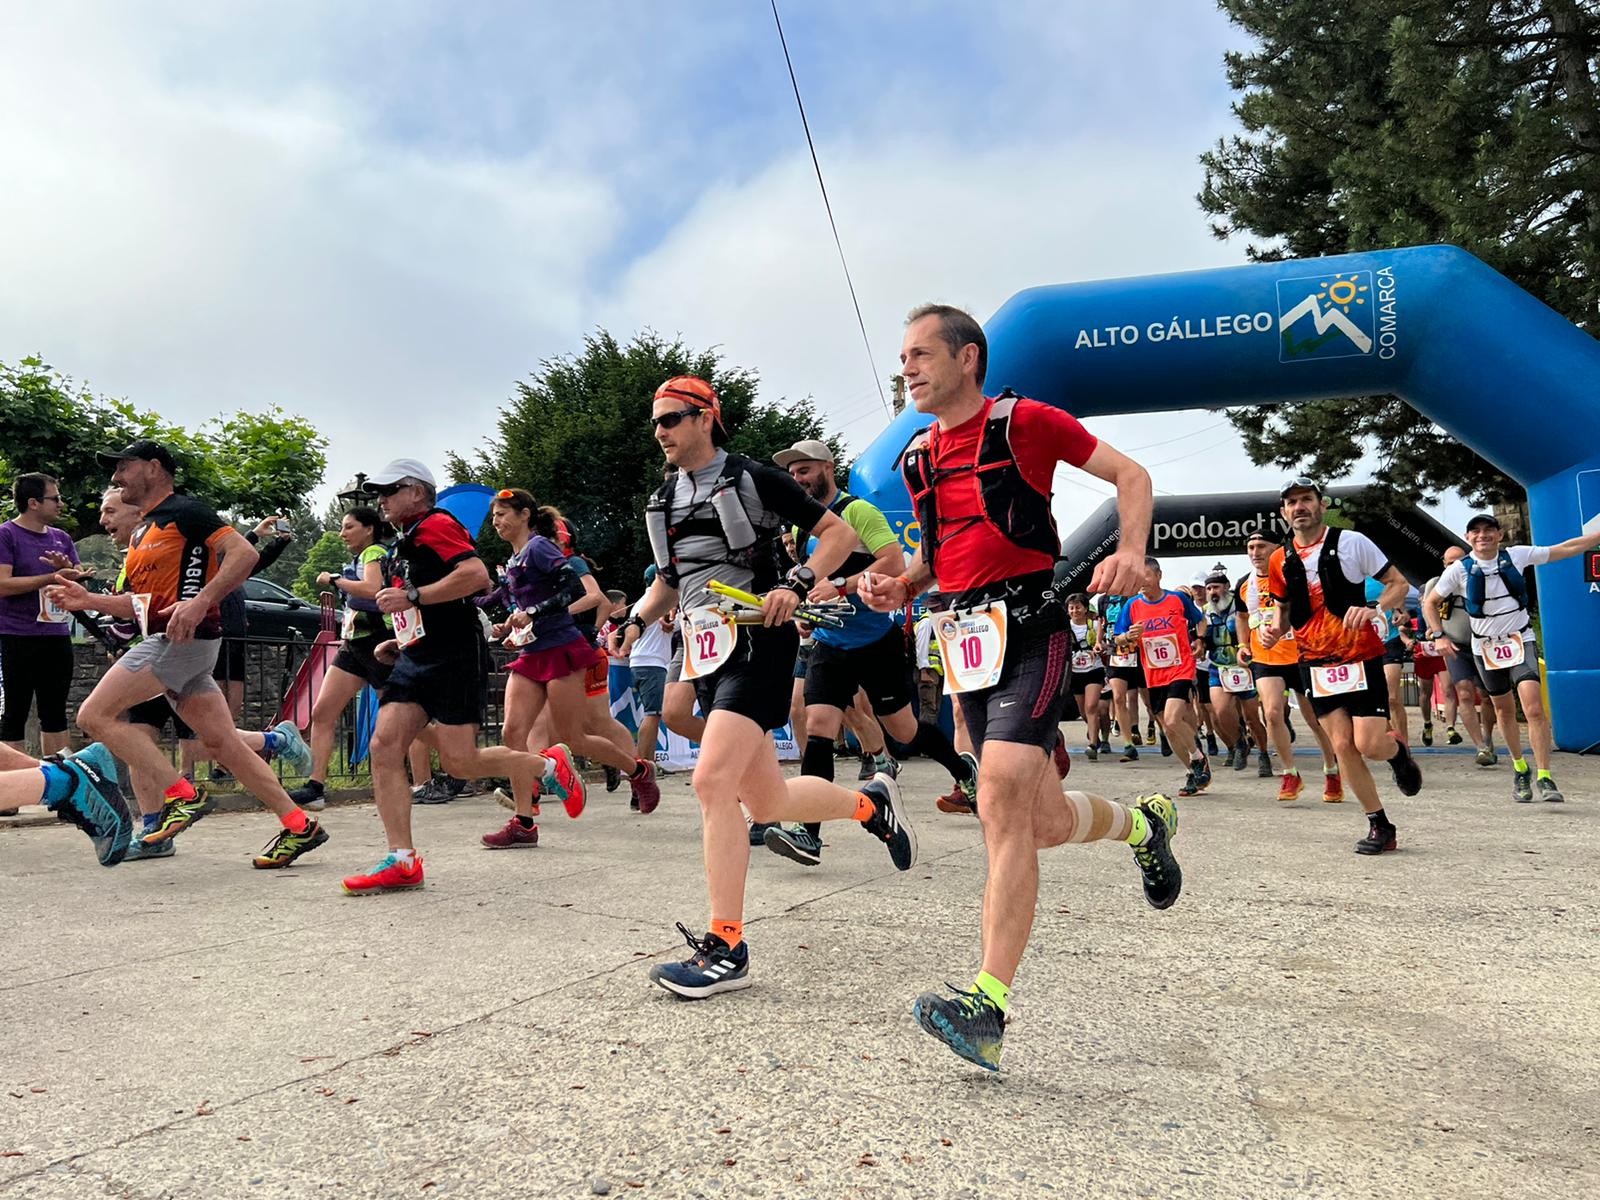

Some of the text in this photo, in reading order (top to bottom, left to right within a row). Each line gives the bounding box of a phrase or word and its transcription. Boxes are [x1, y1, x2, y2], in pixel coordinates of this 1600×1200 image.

[1376, 266, 1397, 360] COMARCA
[1074, 312, 1273, 349] ALTO GÁLLEGO
[1054, 575, 1072, 592] Pisa
[1069, 561, 1090, 578] bien,
[1087, 546, 1103, 561] vive
[1145, 615, 1175, 631] 42K
[696, 631, 718, 660] 22
[960, 636, 982, 669] 10
[1154, 647, 1168, 660] 16
[1494, 646, 1512, 659] 20
[1233, 674, 1240, 685] 9
[1327, 667, 1349, 683] 39
